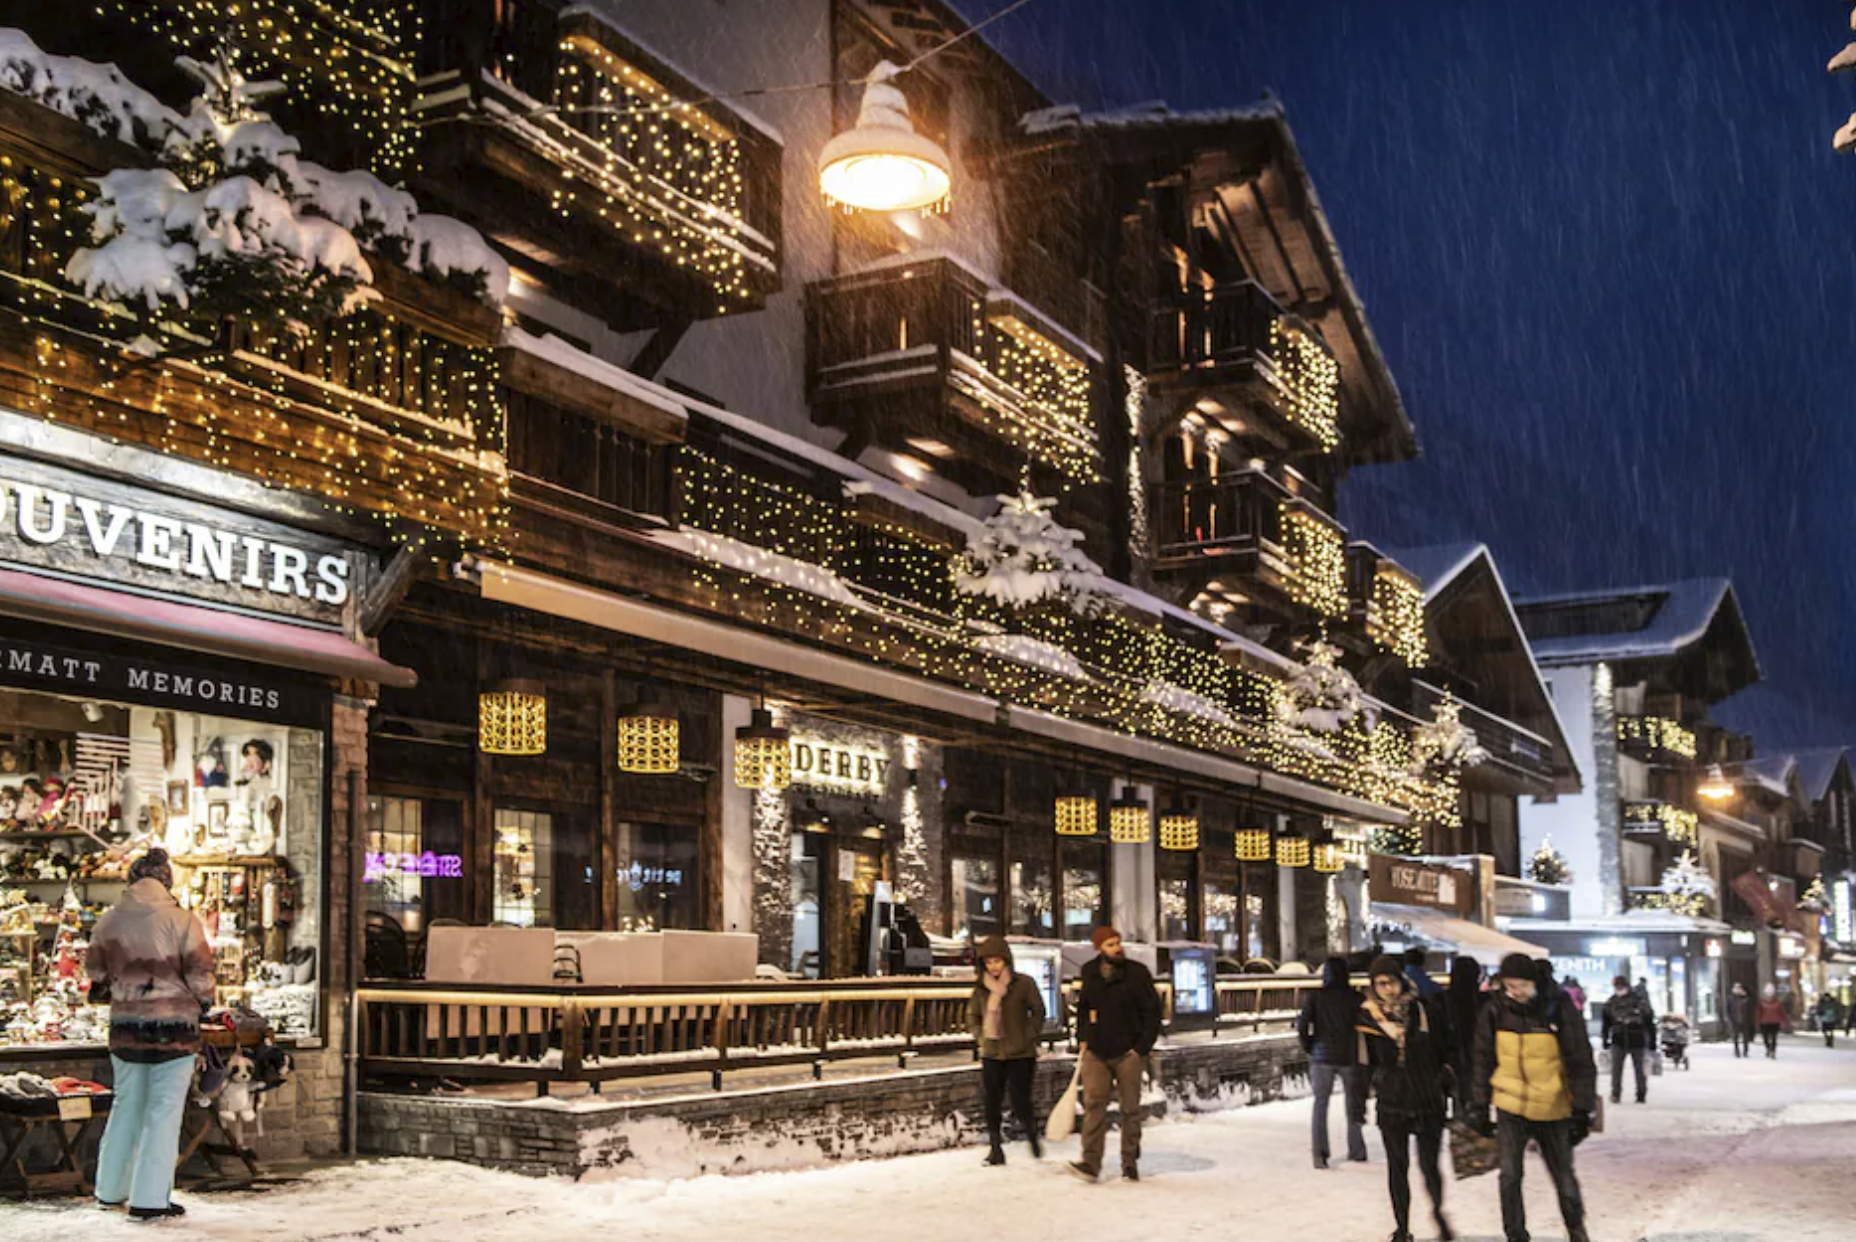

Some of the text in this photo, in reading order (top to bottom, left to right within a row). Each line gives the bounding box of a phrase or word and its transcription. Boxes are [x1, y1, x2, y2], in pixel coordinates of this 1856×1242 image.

[0, 485, 350, 605] UVENIRS
[0, 649, 280, 709] MATT MEMORIES
[794, 743, 891, 784] DERBY
